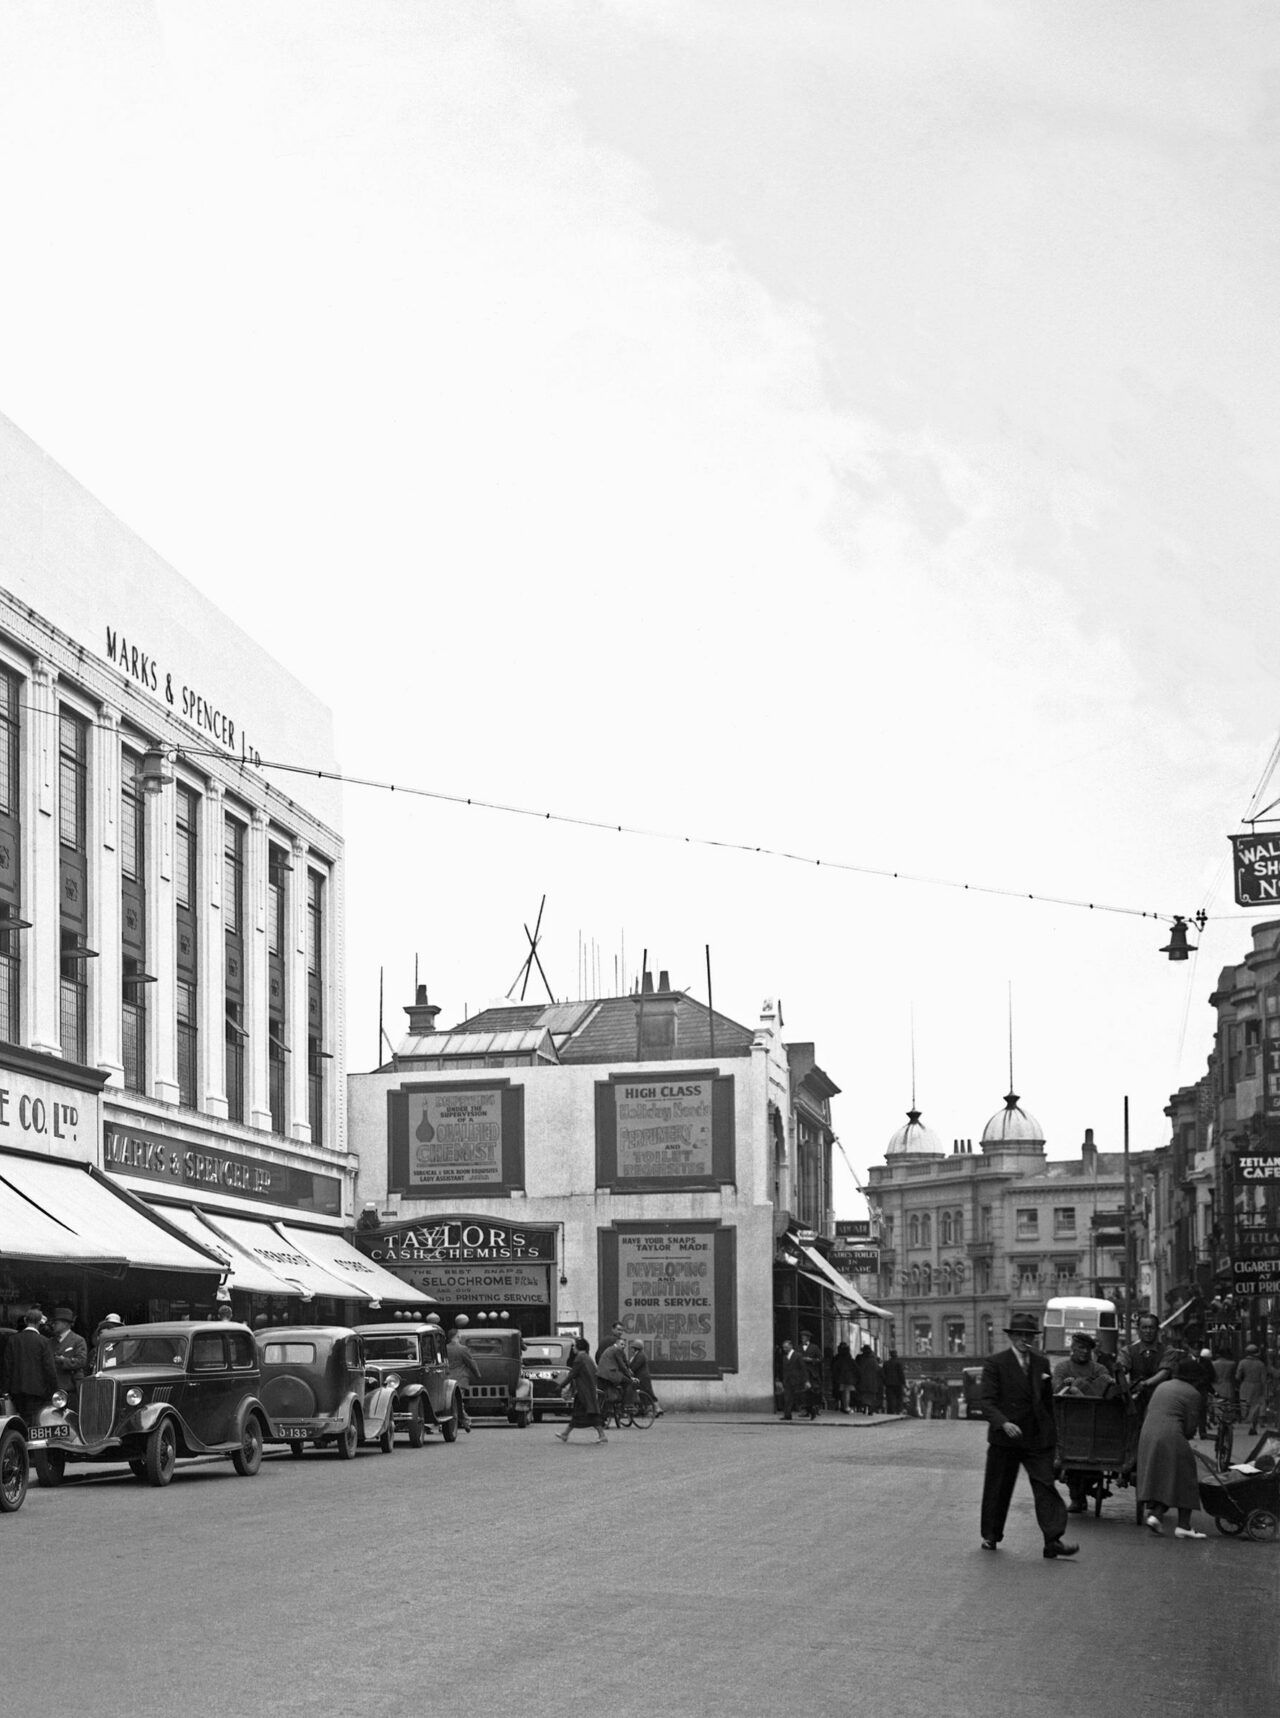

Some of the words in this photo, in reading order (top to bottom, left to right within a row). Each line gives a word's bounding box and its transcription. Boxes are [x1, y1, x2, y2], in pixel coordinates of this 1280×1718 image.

[106, 625, 158, 692] MARKS
[165, 672, 174, 705] &
[182, 685, 235, 750] SPENCER
[625, 1087, 656, 1099] HIGH
[660, 1085, 702, 1098] CLASS
[19, 1094, 48, 1135] CO.
[439, 1111, 488, 1119] SUPERVISION
[446, 1105, 468, 1113] UNDER
[470, 1104, 482, 1112] THE
[415, 1141, 498, 1163] CHEMIST
[632, 1150, 694, 1164] TOILET
[104, 1132, 166, 1172] MARKS
[169, 1152, 183, 1176] &
[183, 1151, 251, 1190] SPENCER
[436, 1174, 466, 1182] ASSISTANT
[667, 1236, 696, 1244] SNAPS
[370, 1249, 424, 1260] CASH
[436, 1247, 540, 1260] CHEMISTS
[626, 1262, 708, 1278] DEVELOPING
[422, 1275, 513, 1287] SELOCHROME
[631, 1280, 701, 1297] PRINTING
[1235, 1282, 1257, 1295] CUT
[455, 1293, 501, 1302] PRINTING
[503, 1293, 545, 1303] SERVICE
[624, 1298, 633, 1307] 6
[634, 1298, 661, 1307] HOUR
[664, 1298, 712, 1307] SERVICE.
[622, 1313, 712, 1335] CAMERAS
[30, 1427, 52, 1440] BBH
[54, 1425, 69, 1437] 43
